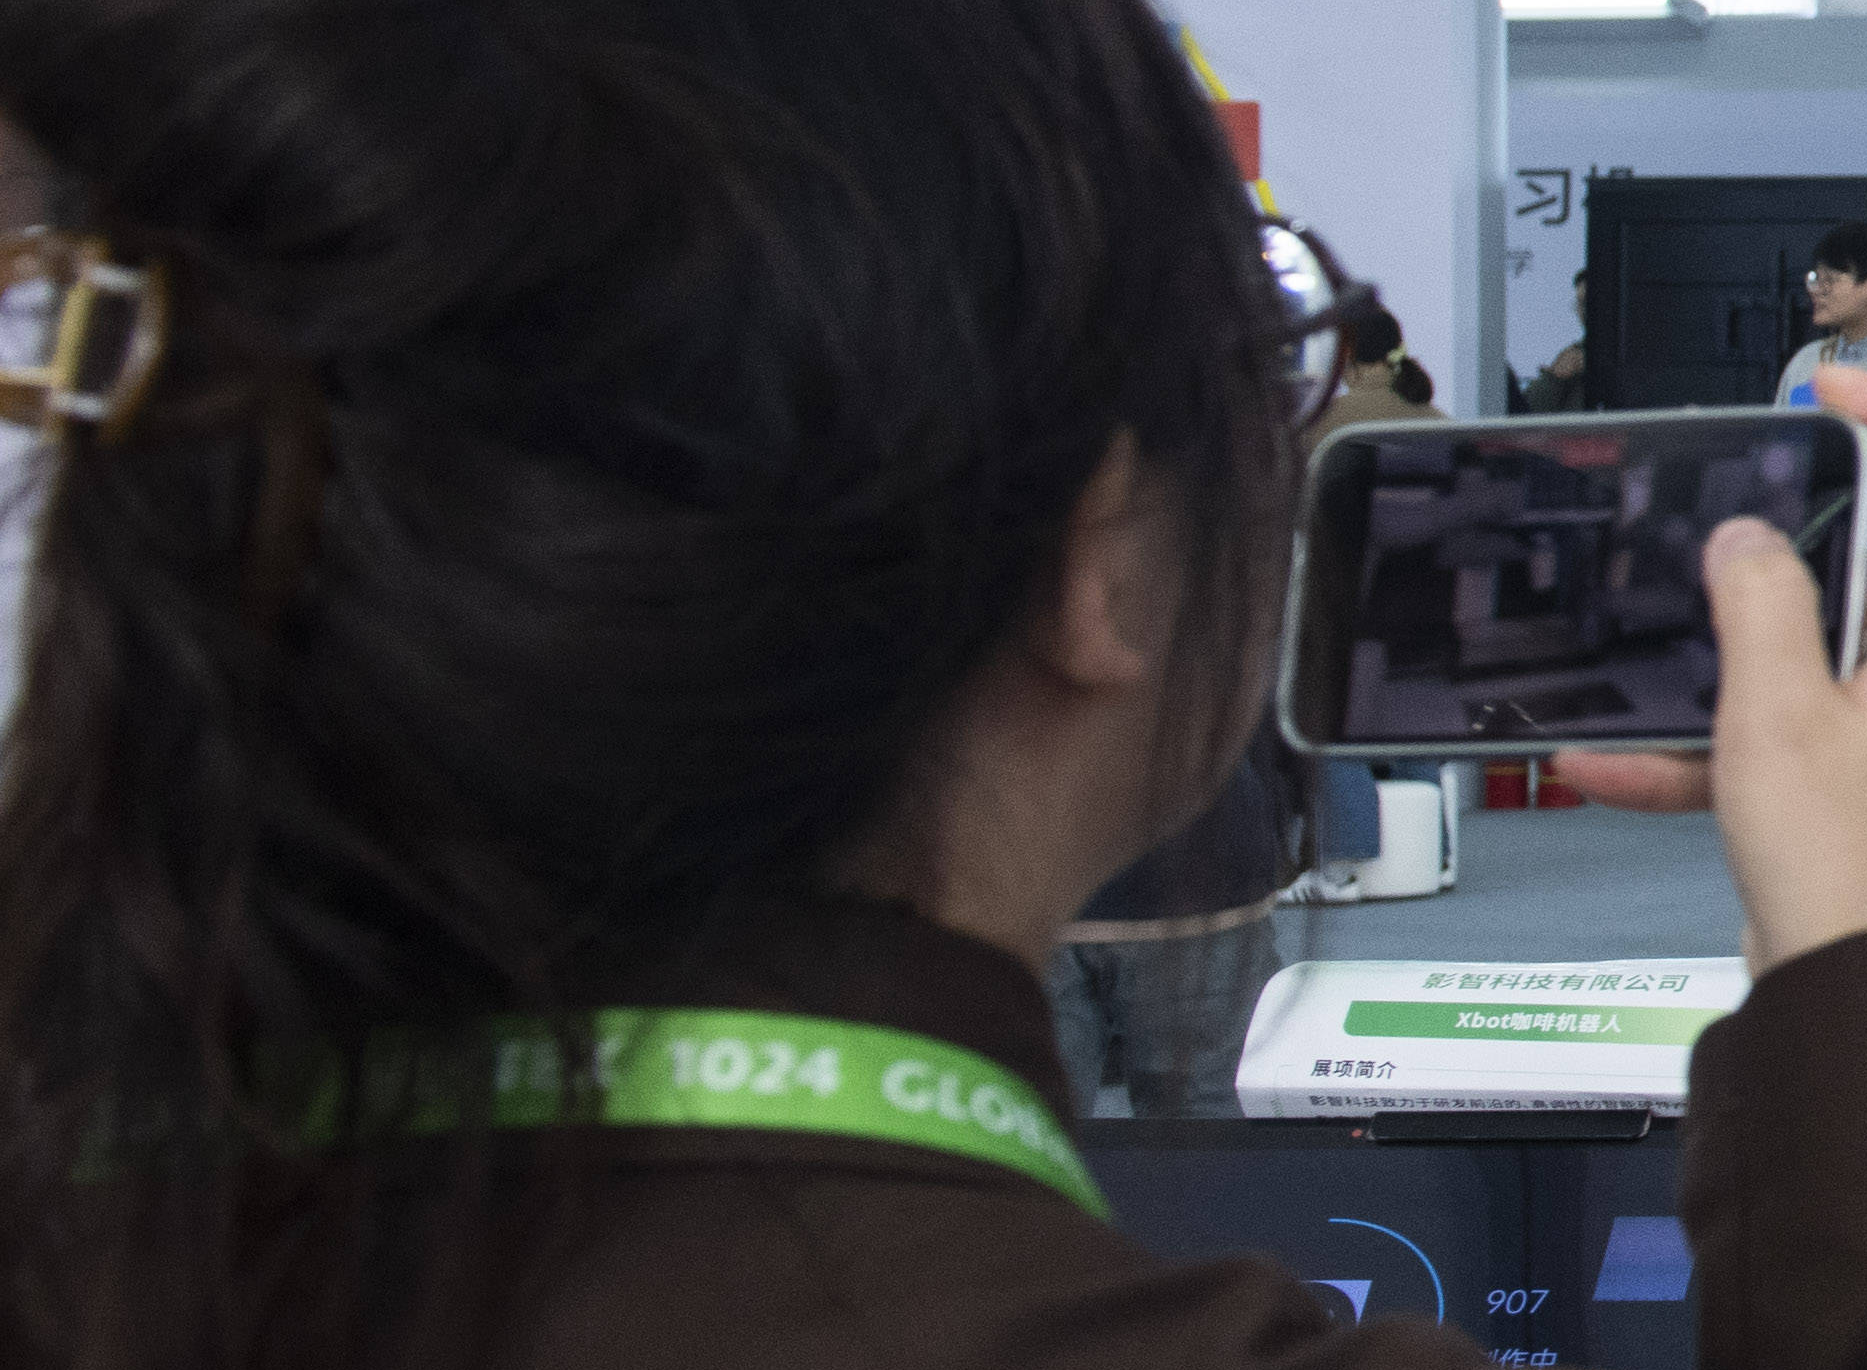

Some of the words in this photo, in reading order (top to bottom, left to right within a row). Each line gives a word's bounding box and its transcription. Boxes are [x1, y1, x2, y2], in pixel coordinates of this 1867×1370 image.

[1421, 971, 1690, 995] 影智科技有限公司
[1455, 1010, 1624, 1036] Xbot咖啡机器人
[668, 1038, 842, 1097] 1024
[1310, 1058, 1398, 1081] 展项简介
[1486, 1288, 1551, 1316] 907
